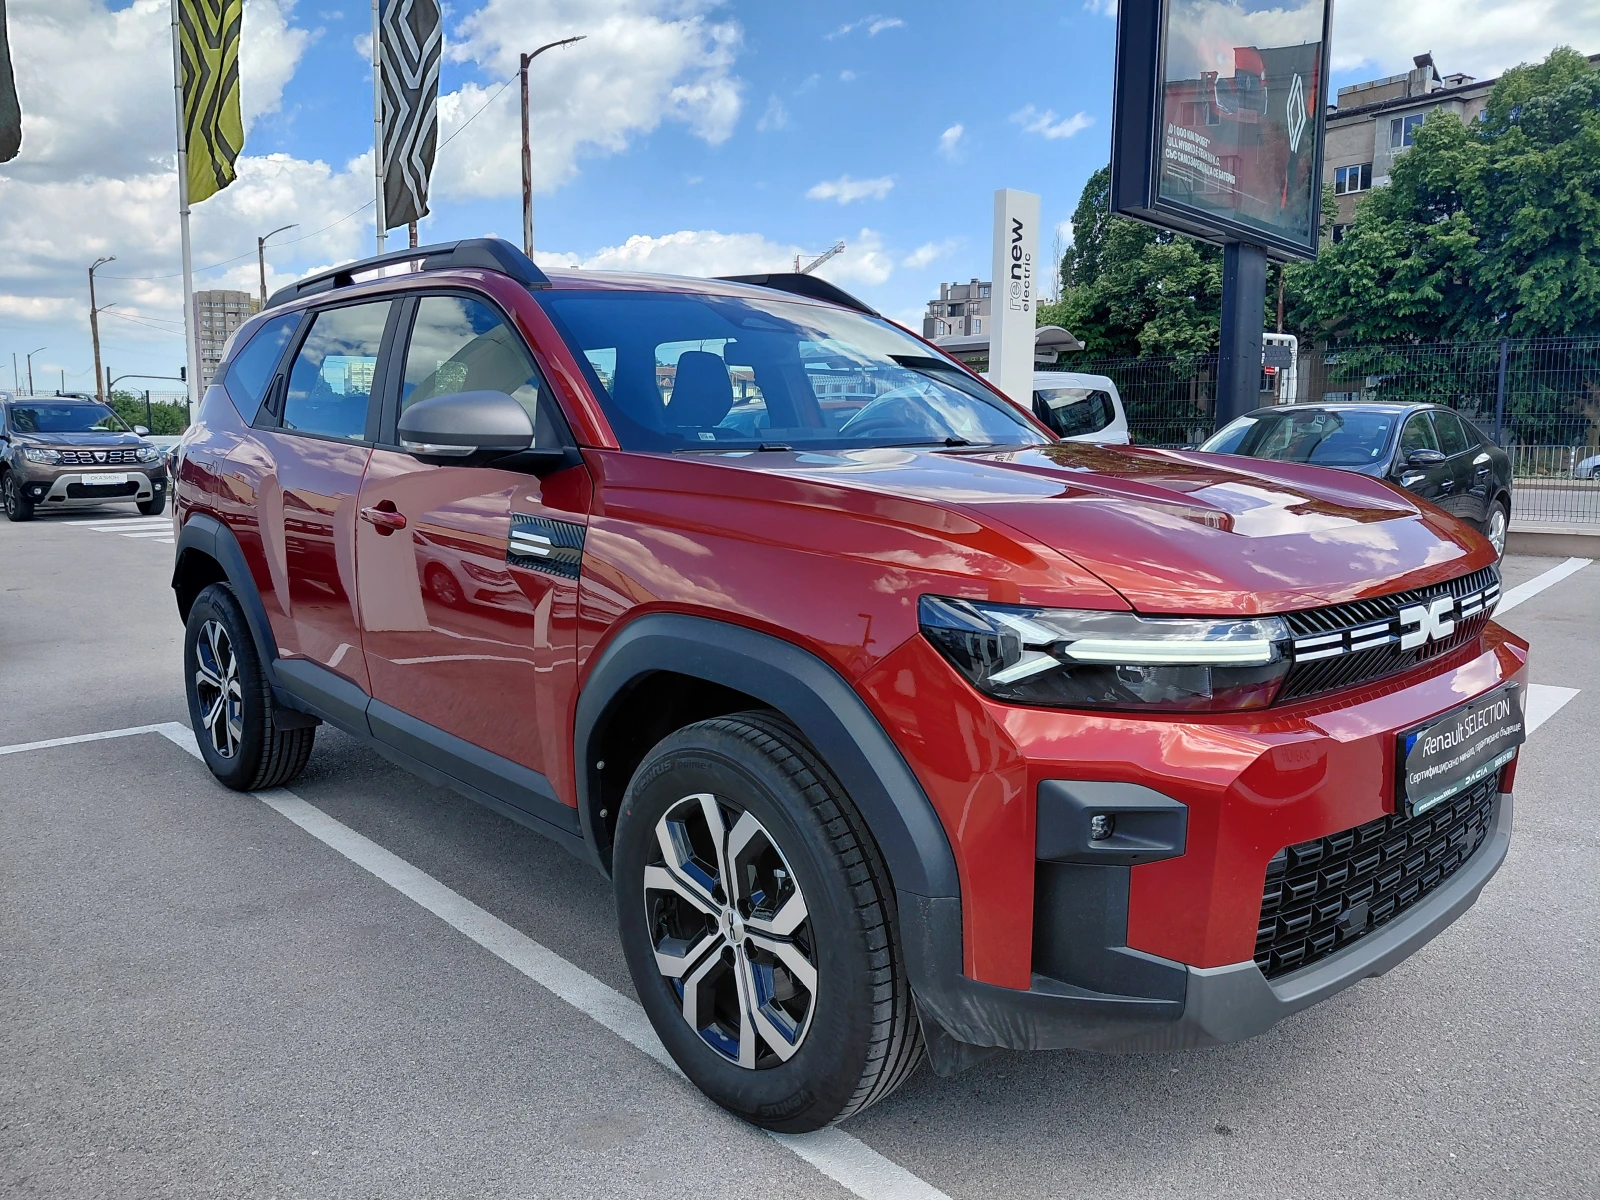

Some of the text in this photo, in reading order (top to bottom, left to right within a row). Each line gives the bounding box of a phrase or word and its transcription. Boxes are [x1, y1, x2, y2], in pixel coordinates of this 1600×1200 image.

[1009, 217, 1024, 311] renew
[1022, 253, 1031, 312] electric
[1422, 698, 1510, 758] Renault SELECTION
[1409, 756, 1459, 785] Сертифицирано
[1465, 767, 1488, 785] DACIA
